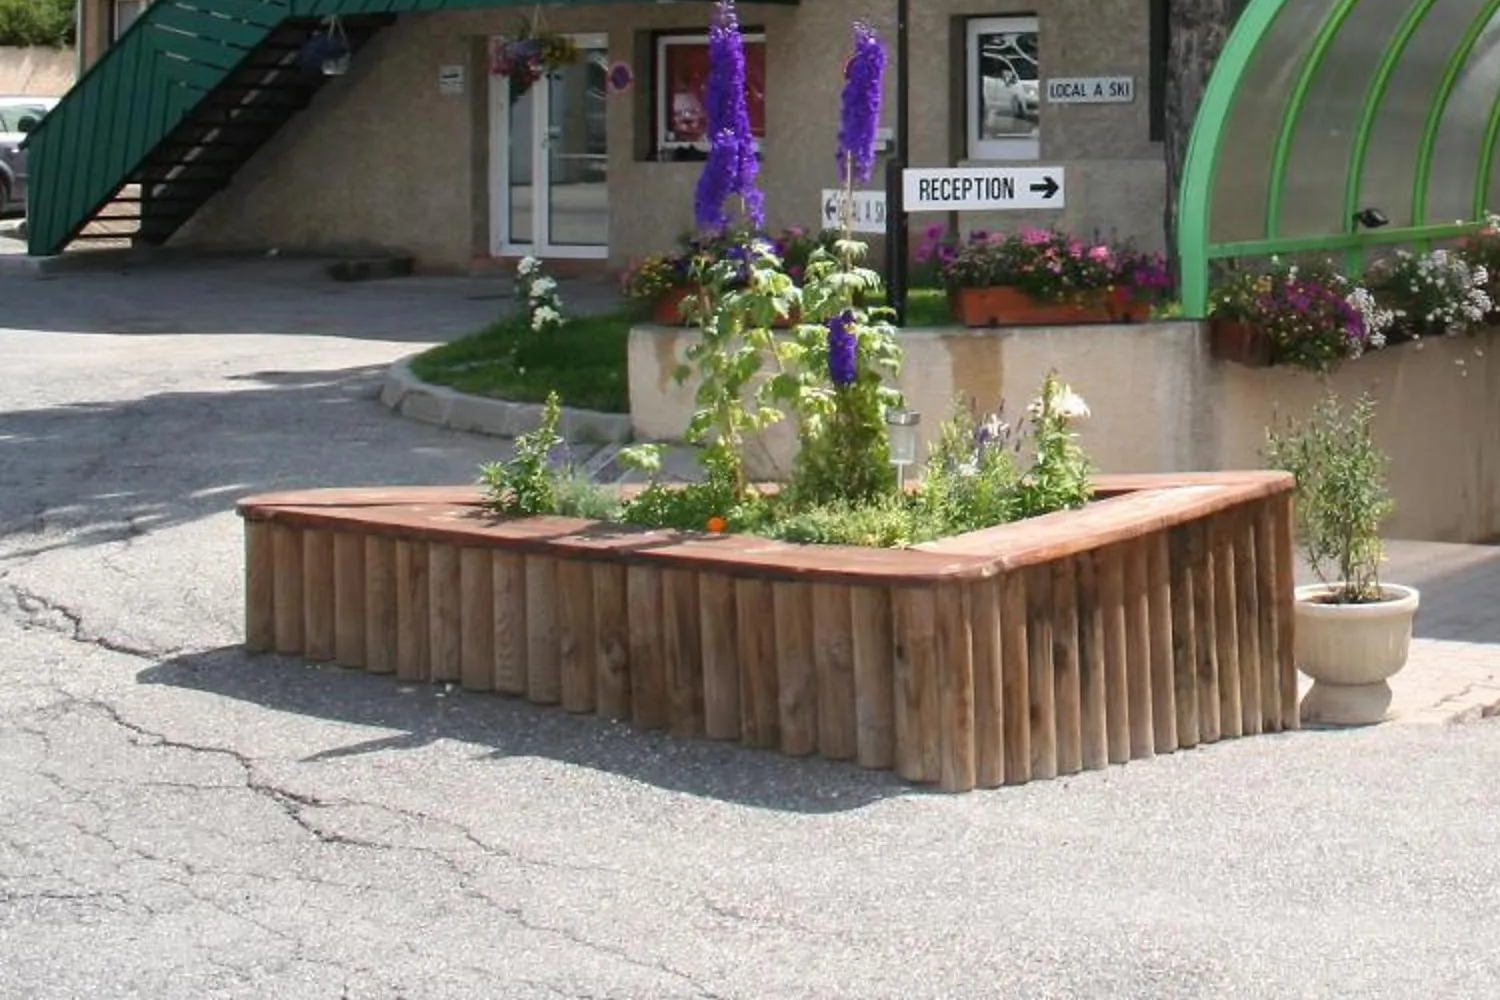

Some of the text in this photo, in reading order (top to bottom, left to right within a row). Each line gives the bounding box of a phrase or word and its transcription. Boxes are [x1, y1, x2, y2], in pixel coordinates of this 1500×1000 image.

[1050, 81, 1129, 98] LOCAL A SKI
[920, 177, 1015, 201] RECEPTION
